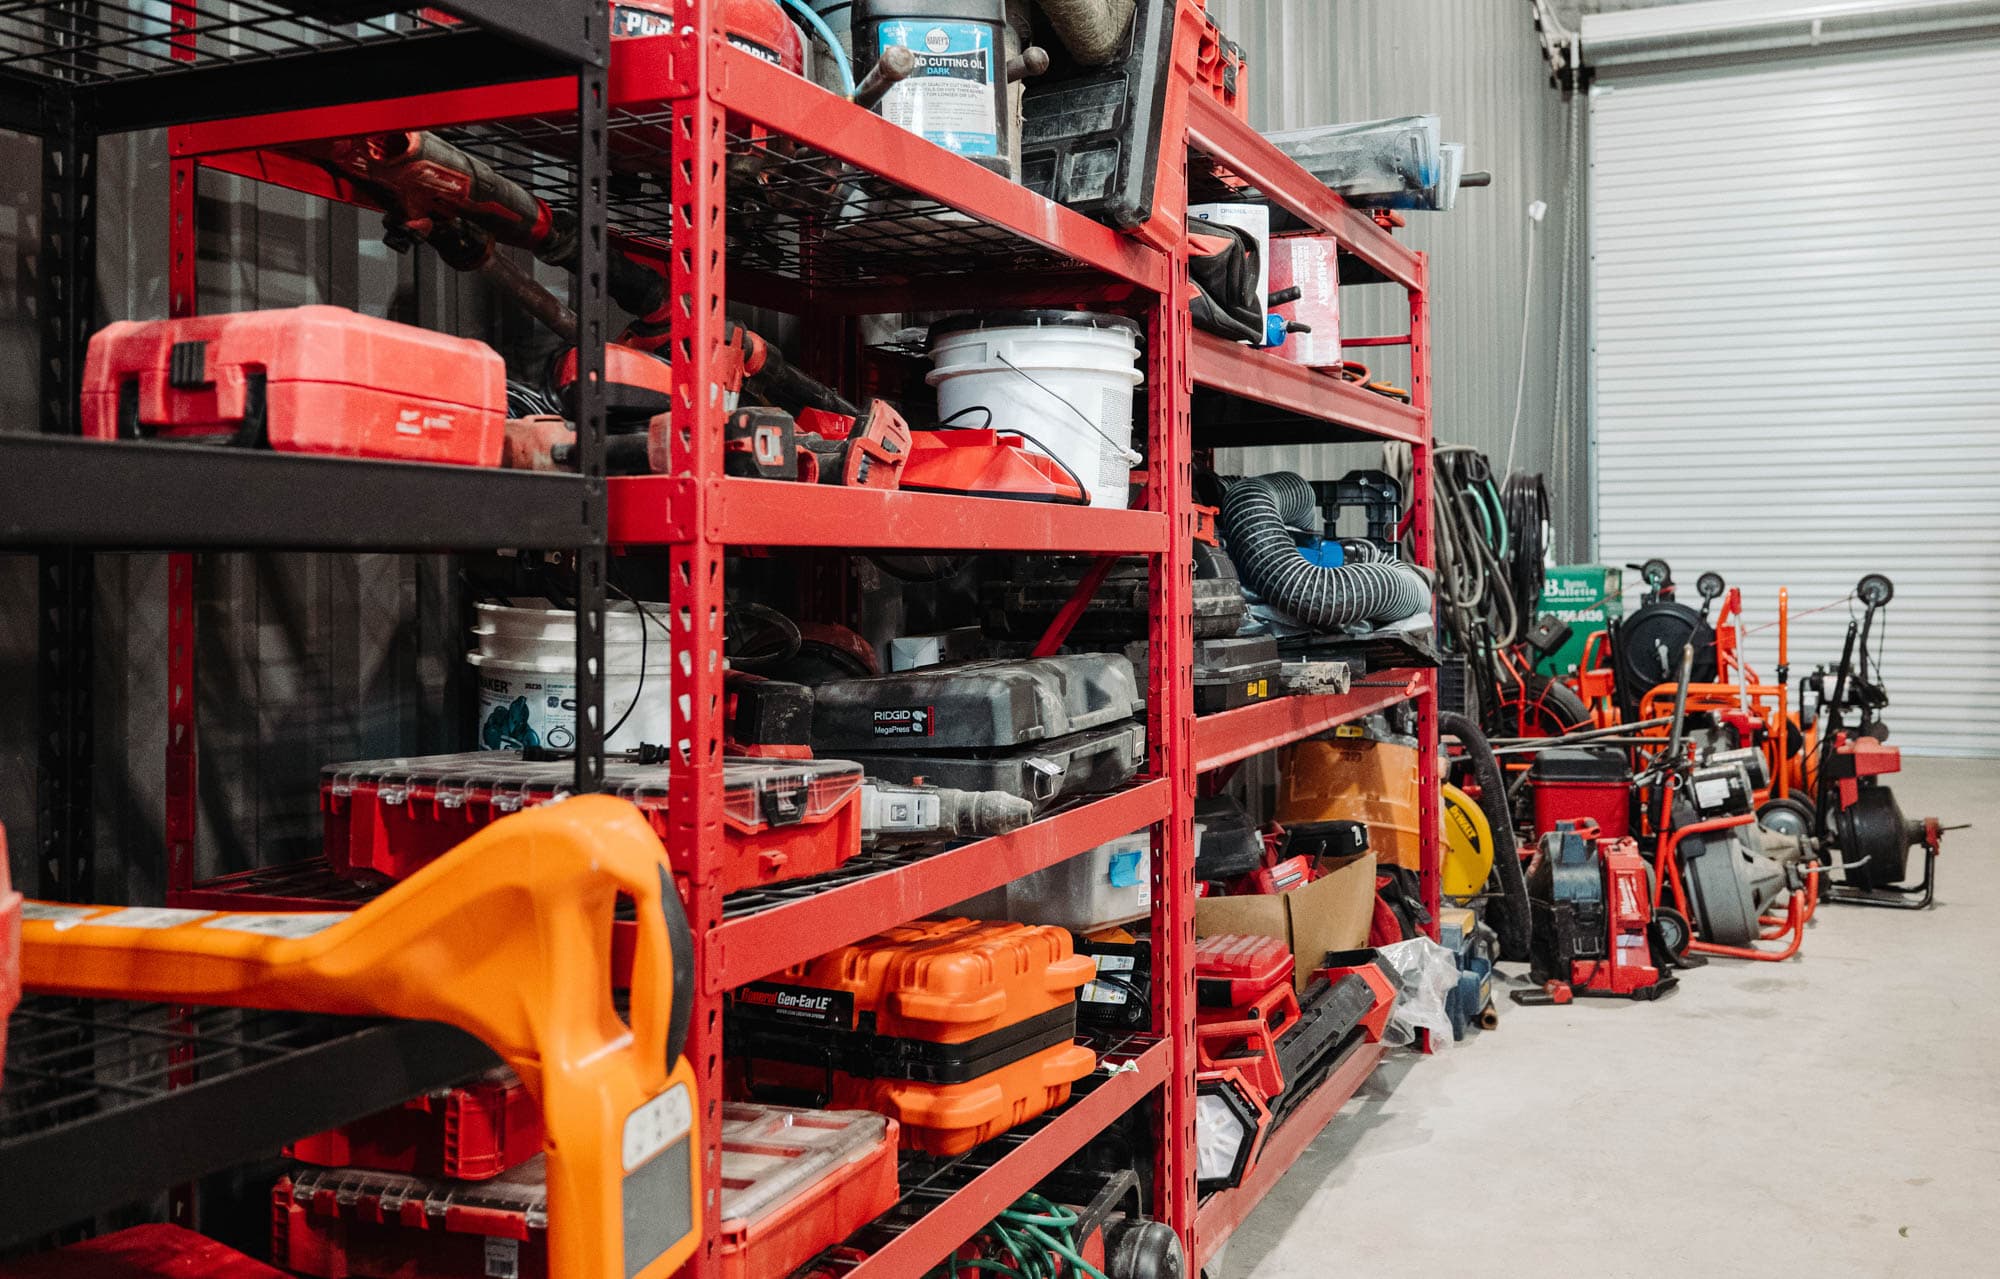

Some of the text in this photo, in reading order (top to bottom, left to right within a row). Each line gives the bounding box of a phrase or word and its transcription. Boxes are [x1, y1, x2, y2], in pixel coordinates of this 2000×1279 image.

[929, 57, 969, 68] CUTTING
[970, 59, 985, 70] OIL
[927, 67, 950, 76] DARK
[1543, 579, 1597, 597] Bulletin
[874, 710, 911, 720] RIDGID
[874, 725, 910, 735] MegaPress
